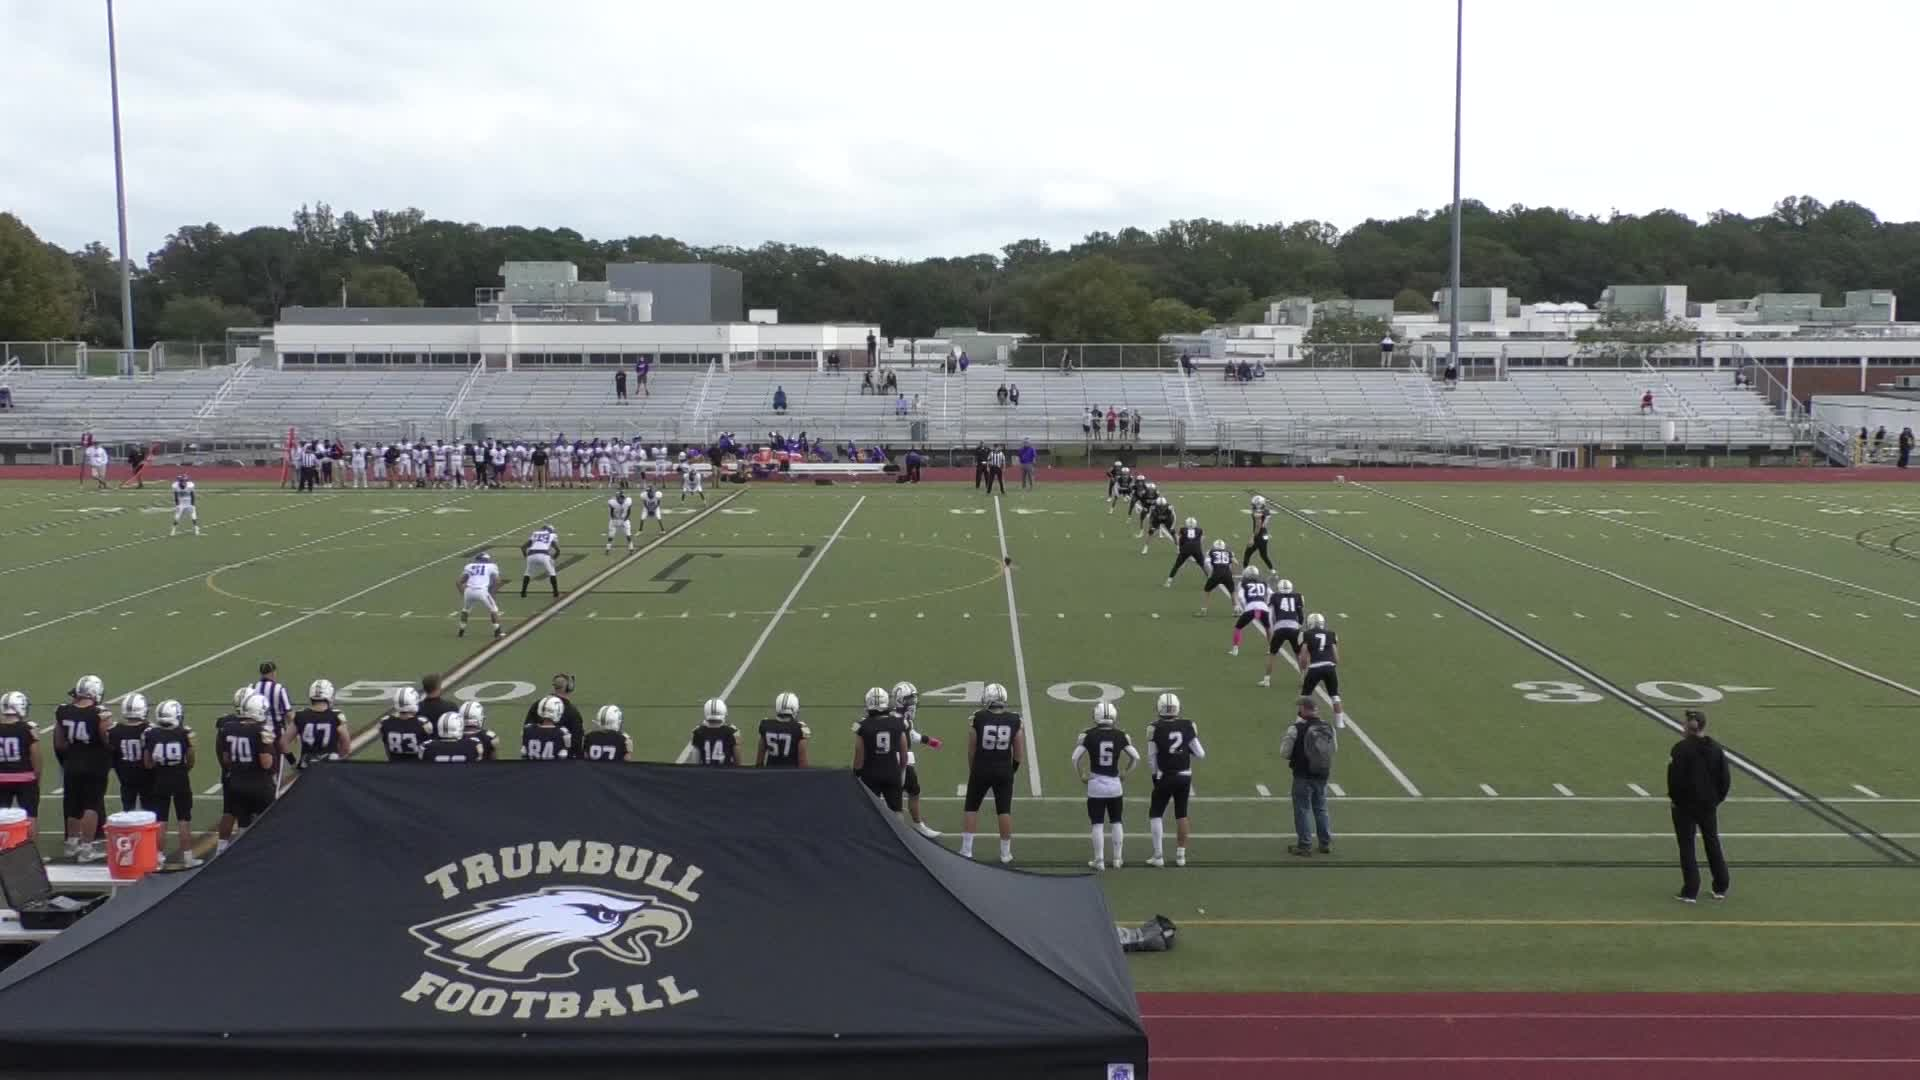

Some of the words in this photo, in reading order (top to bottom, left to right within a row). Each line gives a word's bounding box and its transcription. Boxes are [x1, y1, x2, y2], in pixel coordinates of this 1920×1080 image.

[1246, 583, 1265, 596] 20
[1280, 597, 1295, 612] 41
[1315, 633, 1326, 651] 7
[62, 719, 89, 744] 74
[303, 723, 331, 746] 47
[152, 743, 181, 765] 49
[226, 736, 253, 762] 70
[388, 732, 419, 754] 83
[528, 739, 554, 760] 84
[704, 740, 726, 764] 14
[766, 732, 792, 756] 57
[876, 732, 890, 754] 9
[1099, 741, 1114, 766] 6
[1168, 732, 1183, 754] 2
[424, 839, 703, 902] TRUMBULL
[400, 971, 699, 1019] FOOTBALL
